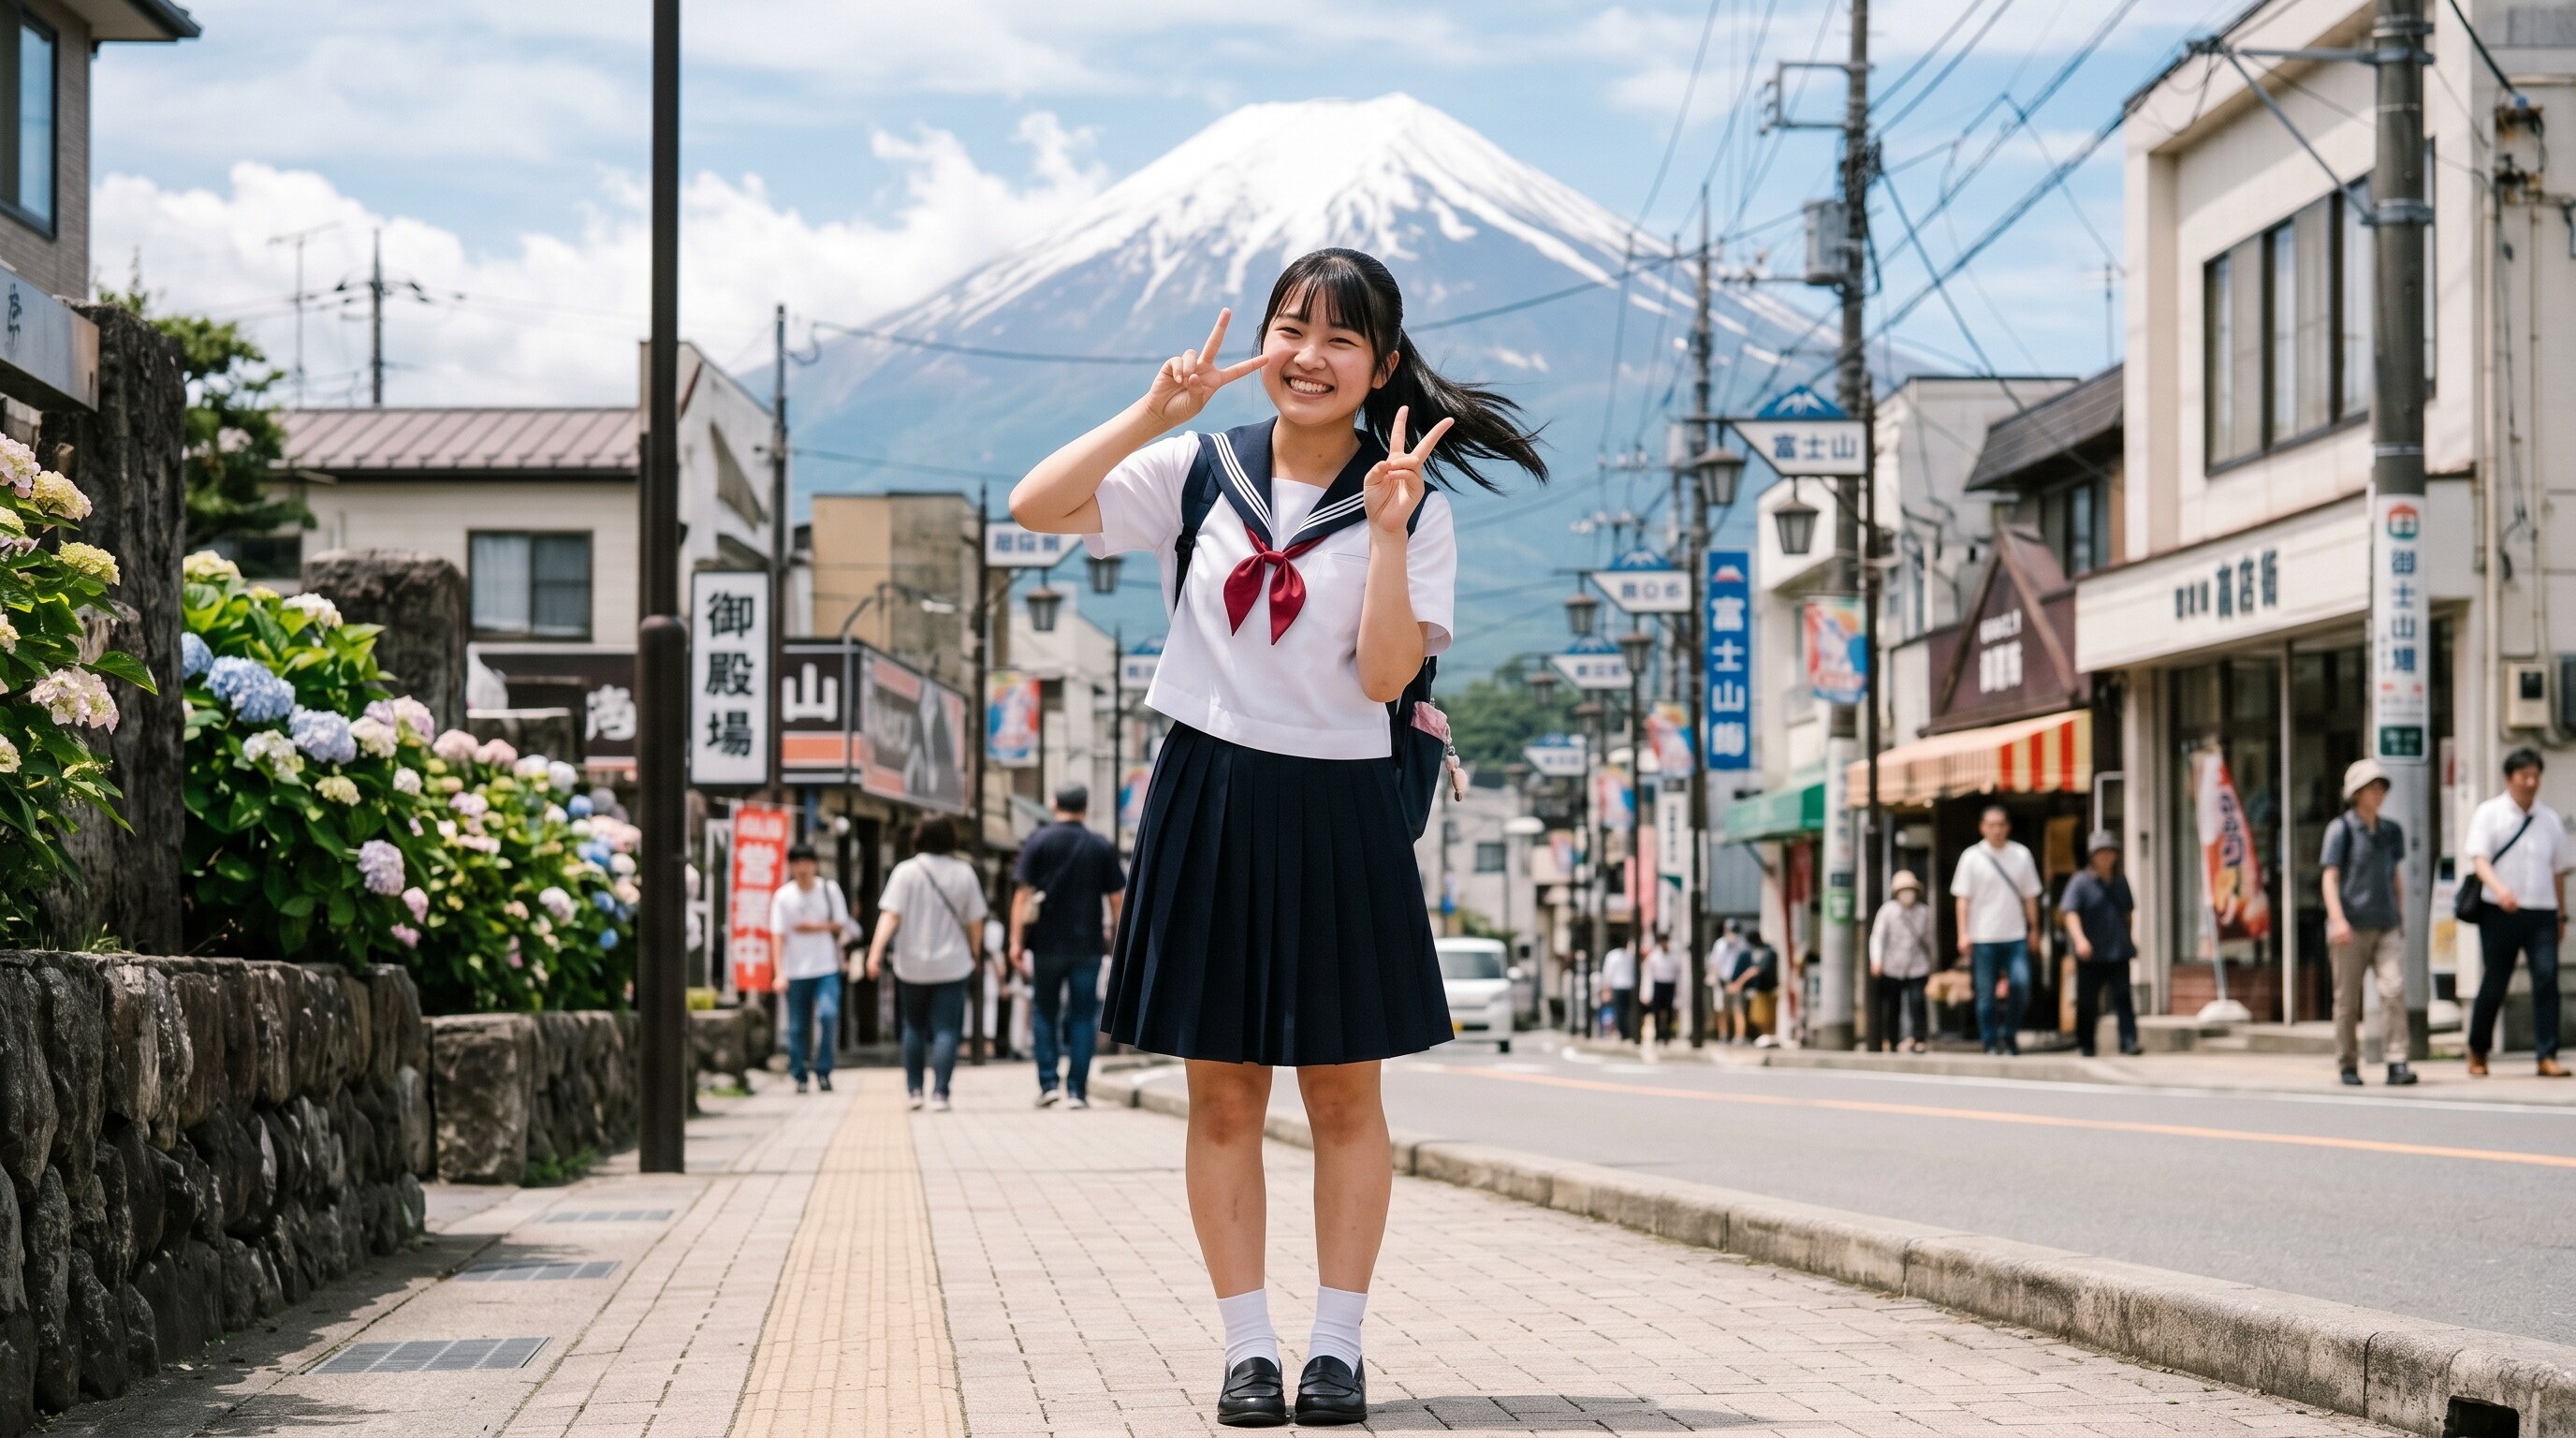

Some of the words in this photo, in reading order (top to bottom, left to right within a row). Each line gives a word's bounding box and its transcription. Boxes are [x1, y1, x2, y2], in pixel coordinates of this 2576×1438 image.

[1773, 433, 1856, 460] 富士山
[706, 592, 754, 756] 御殿場
[781, 662, 838, 723] 山
